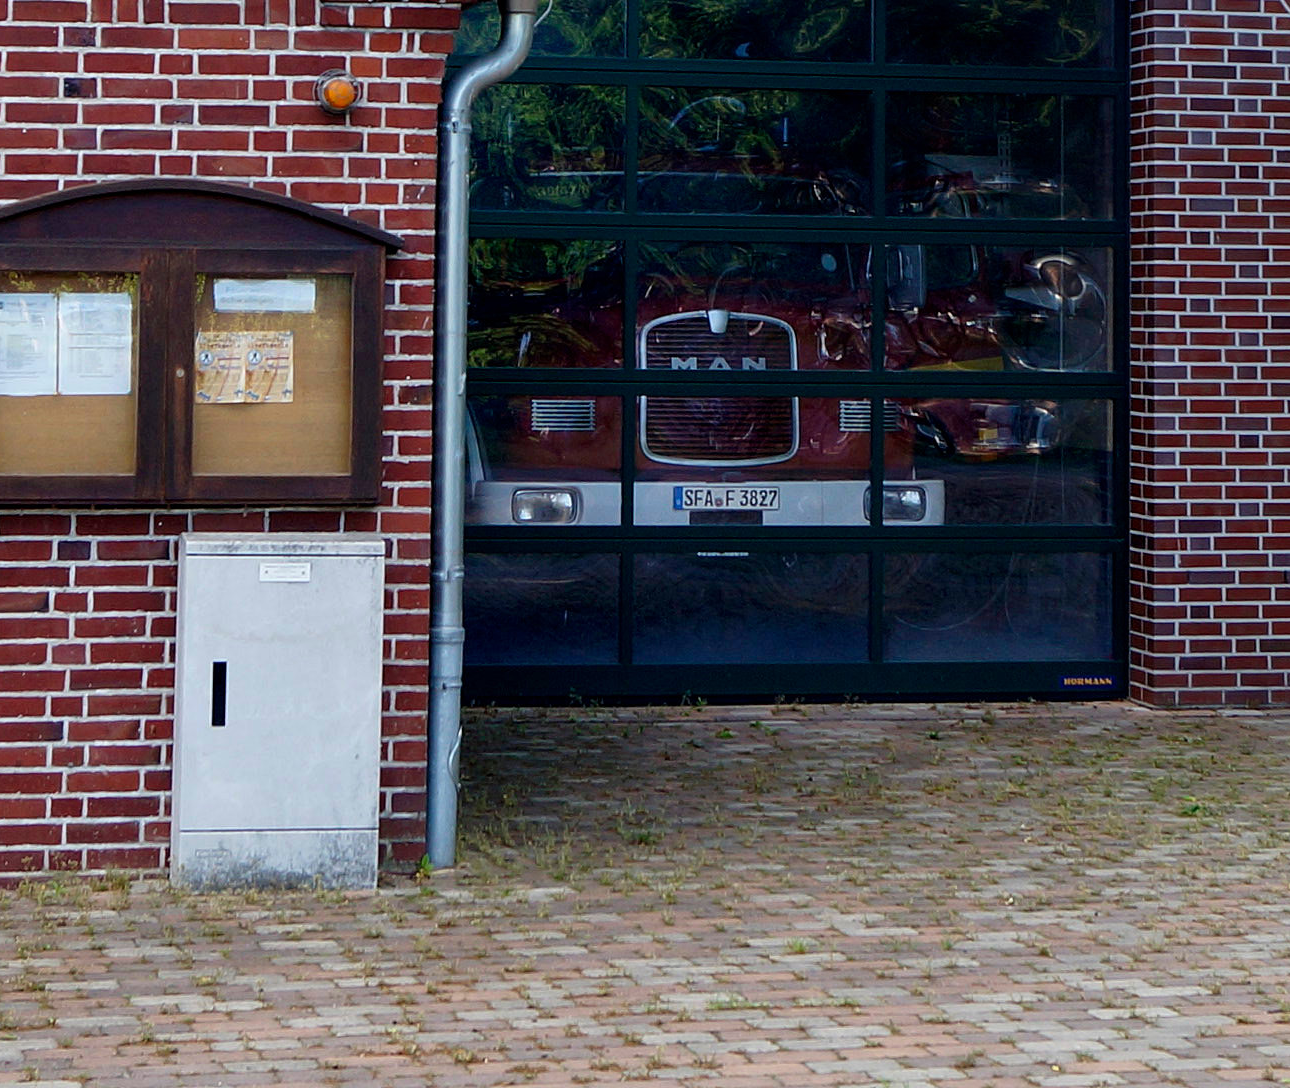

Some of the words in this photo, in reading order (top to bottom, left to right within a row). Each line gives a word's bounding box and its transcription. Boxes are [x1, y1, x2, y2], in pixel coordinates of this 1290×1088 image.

[671, 357, 766, 370] MAN
[684, 489, 714, 507] SFA
[725, 490, 735, 507] F
[739, 490, 778, 507] 3827
